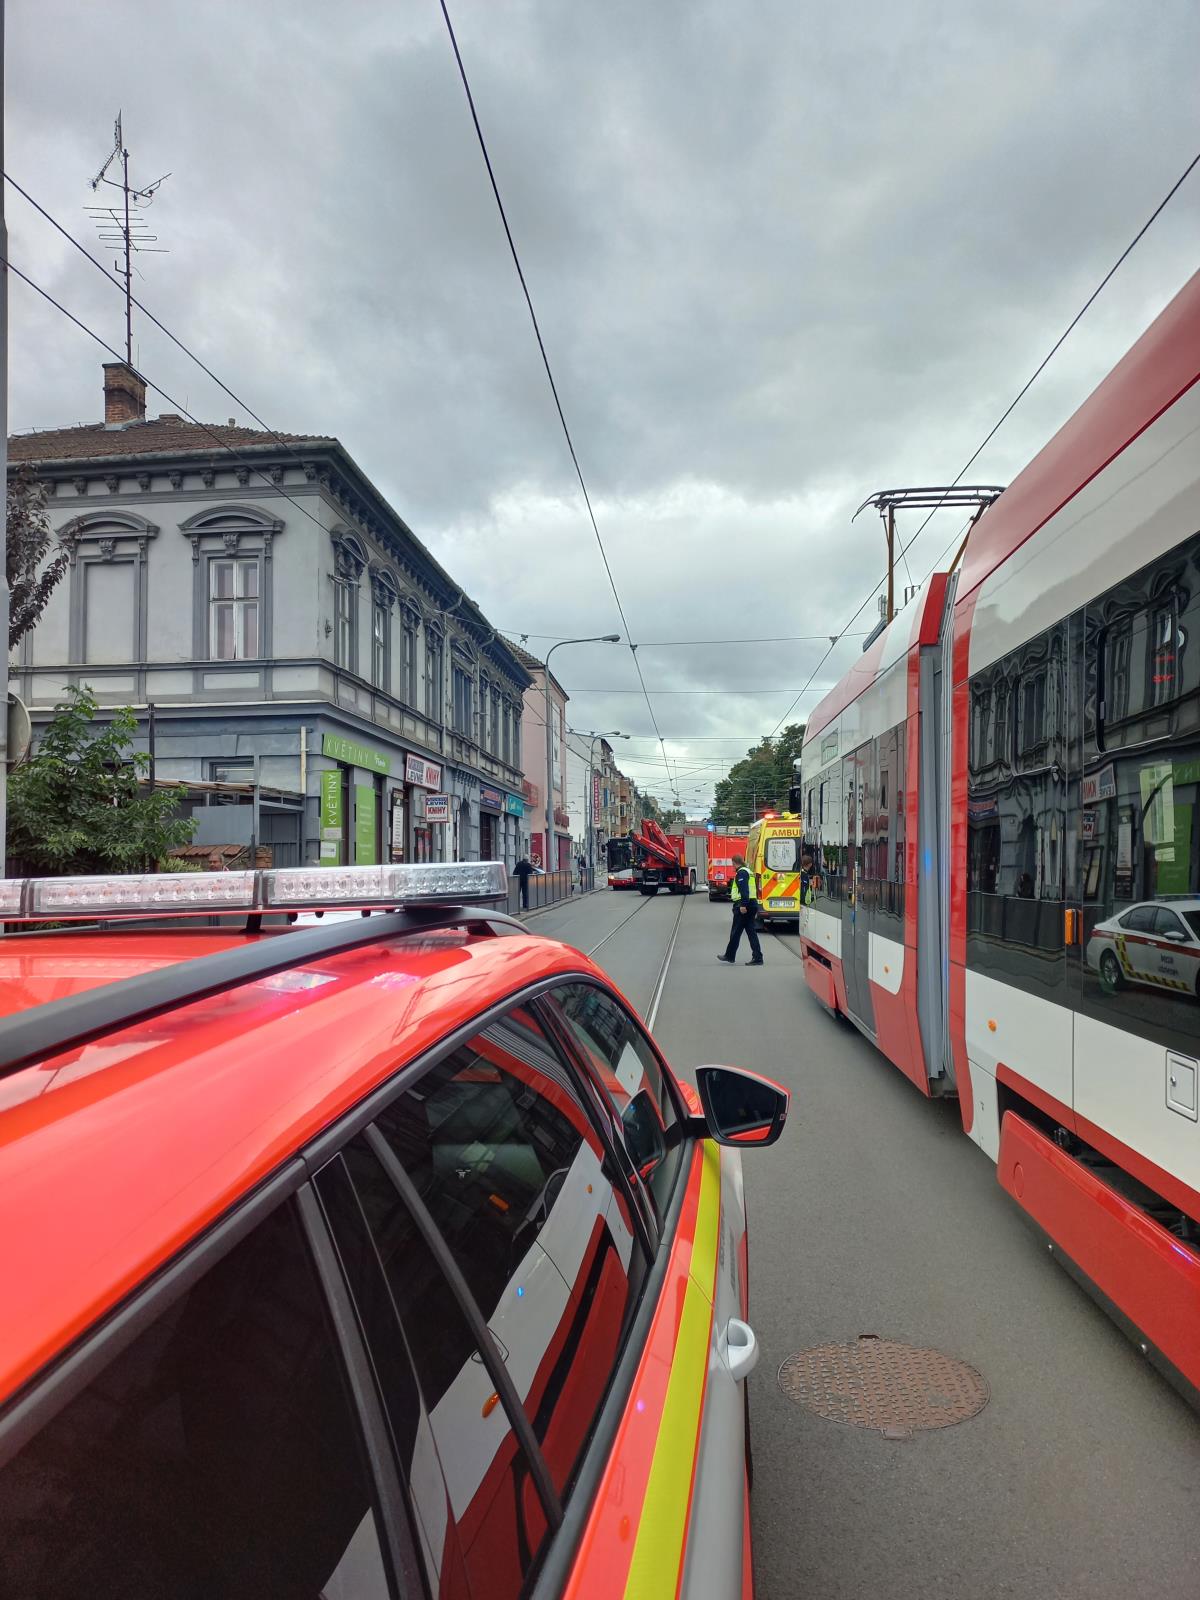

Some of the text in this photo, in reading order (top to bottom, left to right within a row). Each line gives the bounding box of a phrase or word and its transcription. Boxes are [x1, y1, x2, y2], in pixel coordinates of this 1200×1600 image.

[326, 738, 369, 765] KVĚTINY
[326, 773, 337, 825] KVĚTINY
[428, 806, 446, 815] KNIHY
